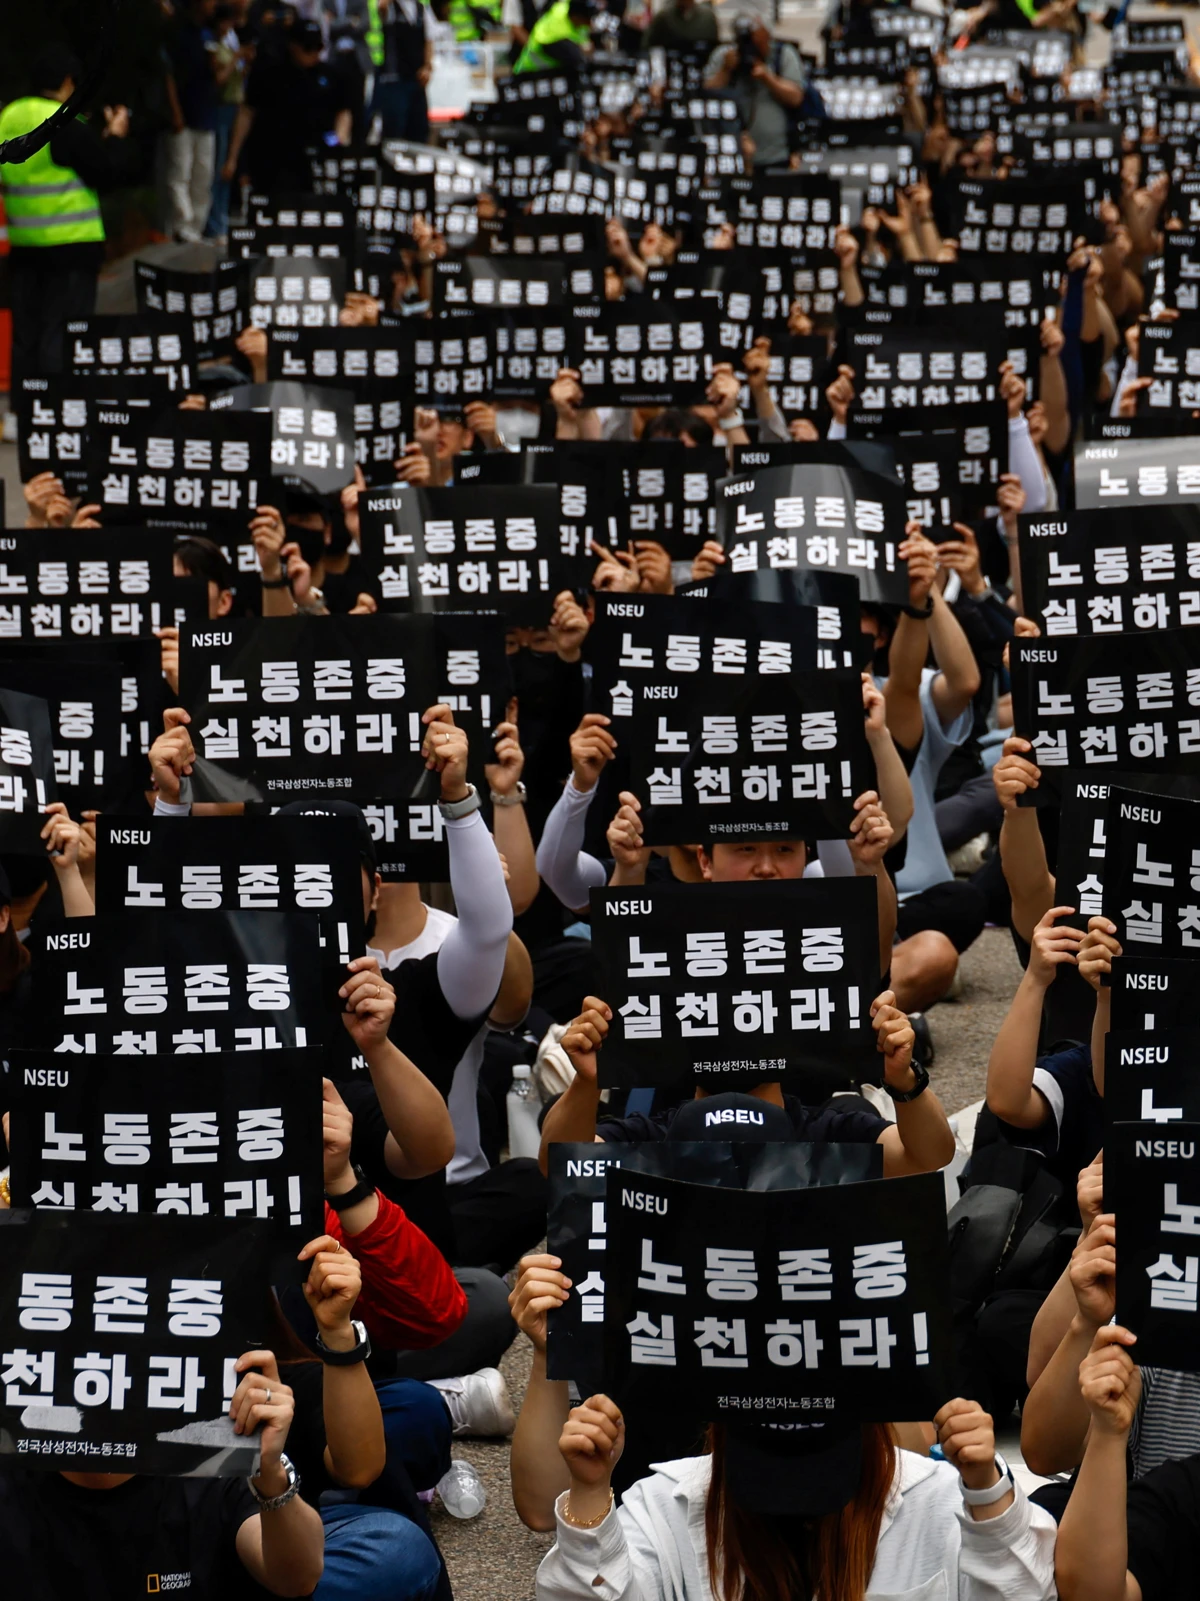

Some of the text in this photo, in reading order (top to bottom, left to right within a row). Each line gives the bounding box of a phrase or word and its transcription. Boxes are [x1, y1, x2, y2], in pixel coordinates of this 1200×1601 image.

[574, 307, 600, 317] NSEU
[584, 322, 703, 351] 노동존중
[854, 335, 882, 344] NSEU
[1145, 328, 1172, 338] NSEU
[282, 350, 398, 376] 노동존중
[580, 355, 712, 383] 실천하라!
[866, 353, 986, 380] 노동존중
[23, 380, 48, 390] NSEU
[99, 412, 129, 424] NSEU
[1103, 426, 1130, 436] NSEU
[109, 436, 249, 471] 노동존중
[741, 453, 769, 464] NSEU
[1086, 449, 1117, 458] NSEU
[461, 466, 480, 478] NSEU
[102, 474, 257, 509] 실천하라!
[725, 481, 754, 496] NSEU
[368, 497, 402, 511] NSEU
[736, 496, 884, 533] 노동존중
[384, 518, 536, 554] 노동존중
[1030, 523, 1067, 536] NSEU
[729, 535, 894, 572] 실천하라!
[0, 561, 150, 594] 노동존중
[379, 560, 548, 598] 실천하라!
[607, 604, 644, 617] NSEU
[0, 603, 162, 637] 실천하라!
[192, 632, 232, 647] NSEU
[619, 633, 792, 673] 노동존중
[1021, 650, 1057, 662] NSEU
[209, 659, 405, 702] 노동존중
[644, 687, 678, 698] NSEU
[200, 713, 420, 759] 실천하라!
[655, 711, 837, 753] 노동존중
[268, 778, 352, 789] 전국삼성전자노동조합
[646, 761, 851, 804] 실천하라!
[1121, 804, 1161, 824] NSEU
[710, 822, 788, 833] 전국삼성전자노동조합
[111, 830, 150, 844] NSEU
[125, 865, 333, 908] 노동존중
[606, 900, 652, 915] NSEU
[47, 933, 90, 950] NSEU
[628, 927, 844, 977] 노동존중
[64, 964, 290, 1015] 노동존중
[1126, 974, 1168, 990] NSEU
[618, 986, 860, 1039] 실천하라!
[1121, 1047, 1168, 1065] NSEU
[694, 1059, 786, 1072] 전국삼성전자노동조합
[25, 1069, 68, 1087] NSEU
[706, 1109, 763, 1126] NSEU
[42, 1108, 284, 1164] 노동존중
[1136, 1141, 1194, 1158] NSEU
[31, 1176, 301, 1225] 실천하라!
[622, 1189, 667, 1215] NSEU
[638, 1239, 906, 1300] 노동존중
[626, 1311, 929, 1368] 실천하라!
[718, 1396, 835, 1409] 전국삼성전자노동조합
[17, 1439, 137, 1457] 전국삼성전자노동조합
